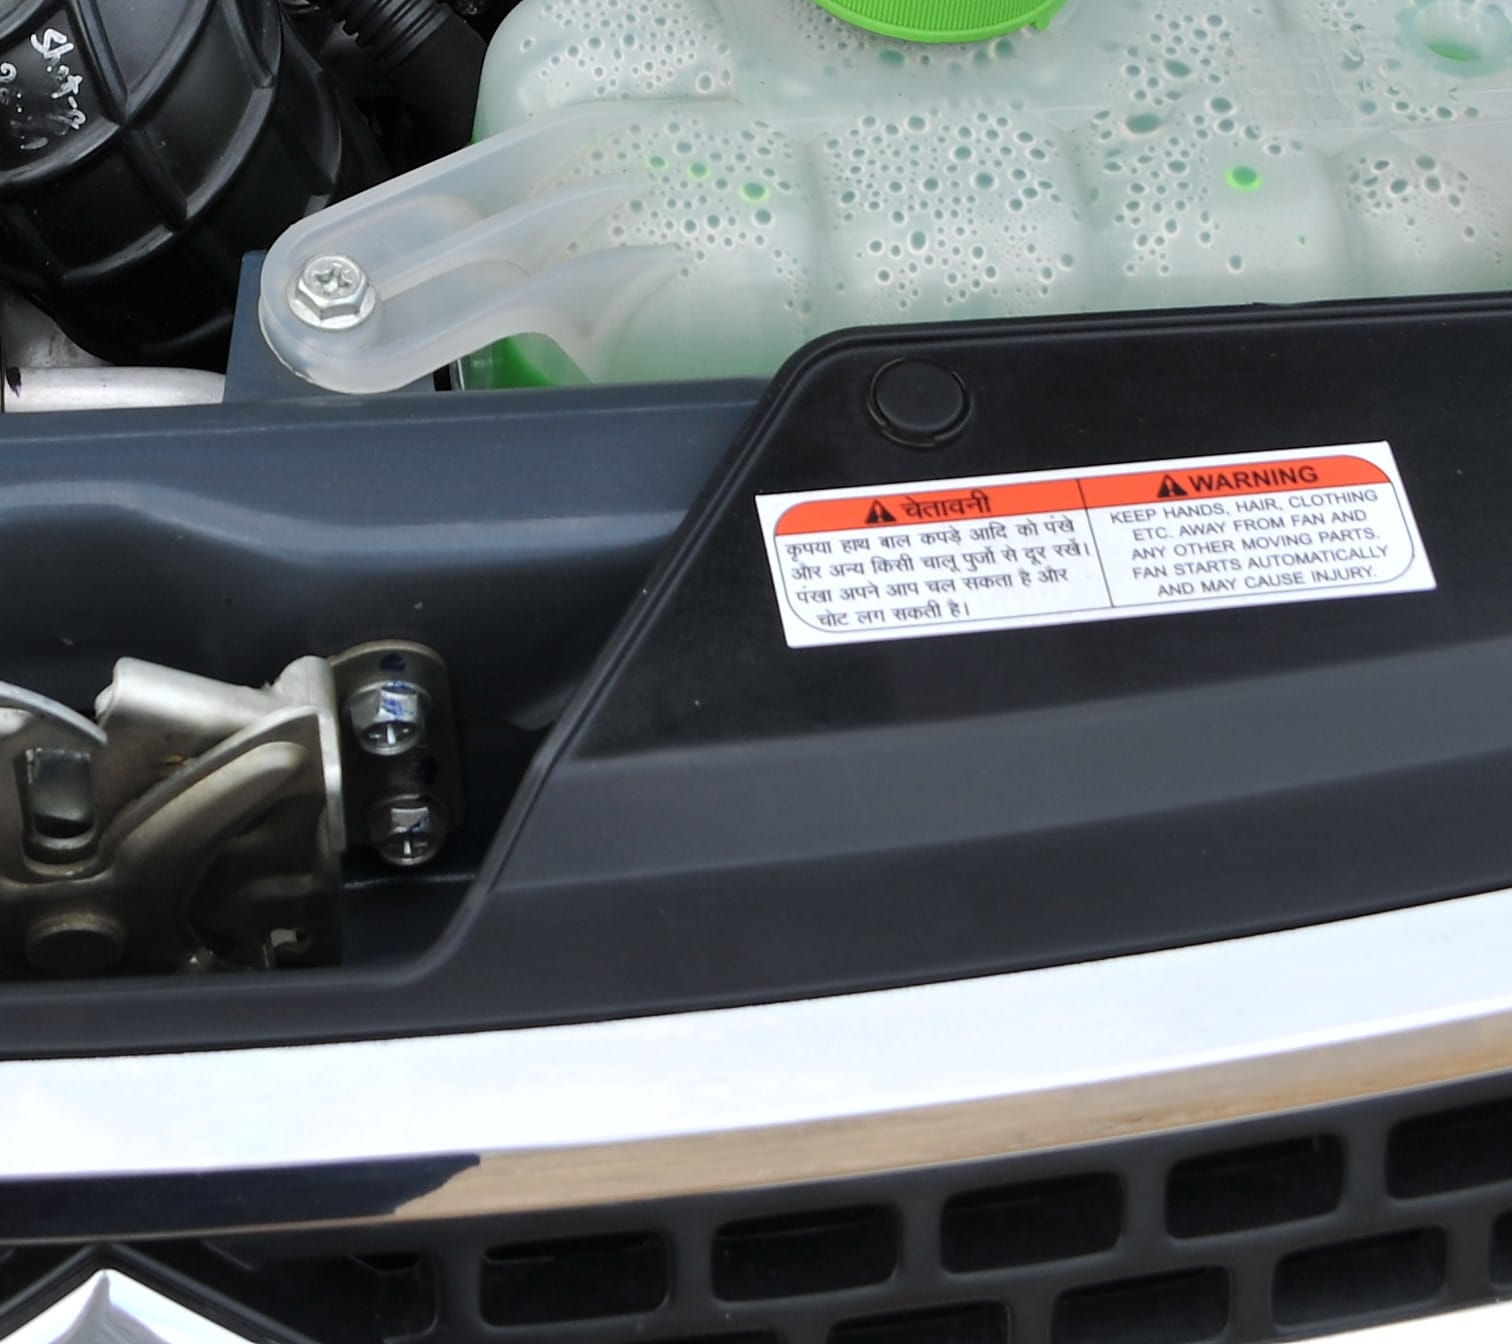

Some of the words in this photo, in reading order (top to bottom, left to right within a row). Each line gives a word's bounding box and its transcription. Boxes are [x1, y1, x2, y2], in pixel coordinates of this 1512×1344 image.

[1188, 466, 1318, 492] WARNING
[900, 489, 990, 518] चेतावनी
[1109, 508, 1156, 523] KEEP
[1162, 502, 1229, 518] HANDS,
[1235, 498, 1282, 512] HAIR,
[1288, 489, 1377, 508] CLOTHING
[1132, 526, 1170, 541] ETC.
[1179, 521, 1224, 536] AWAY
[1232, 516, 1285, 531] FROM
[1290, 513, 1325, 526] FAN
[1331, 509, 1366, 522] AND
[1131, 546, 1165, 560] ANY
[1173, 539, 1235, 556] OTHER
[1241, 532, 1312, 549] MOVING
[1318, 527, 1378, 542] PARTS.
[1132, 565, 1167, 579] FAN
[1173, 558, 1241, 575] STARTS
[1247, 545, 1386, 568] AUTOMATICALLY
[796, 586, 832, 603] पंखा
[840, 582, 879, 600] अपने
[886, 582, 919, 596] आप
[926, 579, 955, 592] चल
[961, 573, 1012, 589] सकता
[1018, 568, 1031, 586] है
[1038, 566, 1067, 582] और
[1158, 582, 1194, 596] AND
[1200, 578, 1235, 592] MAY
[1244, 571, 1304, 588] CAUSE
[1311, 566, 1375, 582] INJURY.
